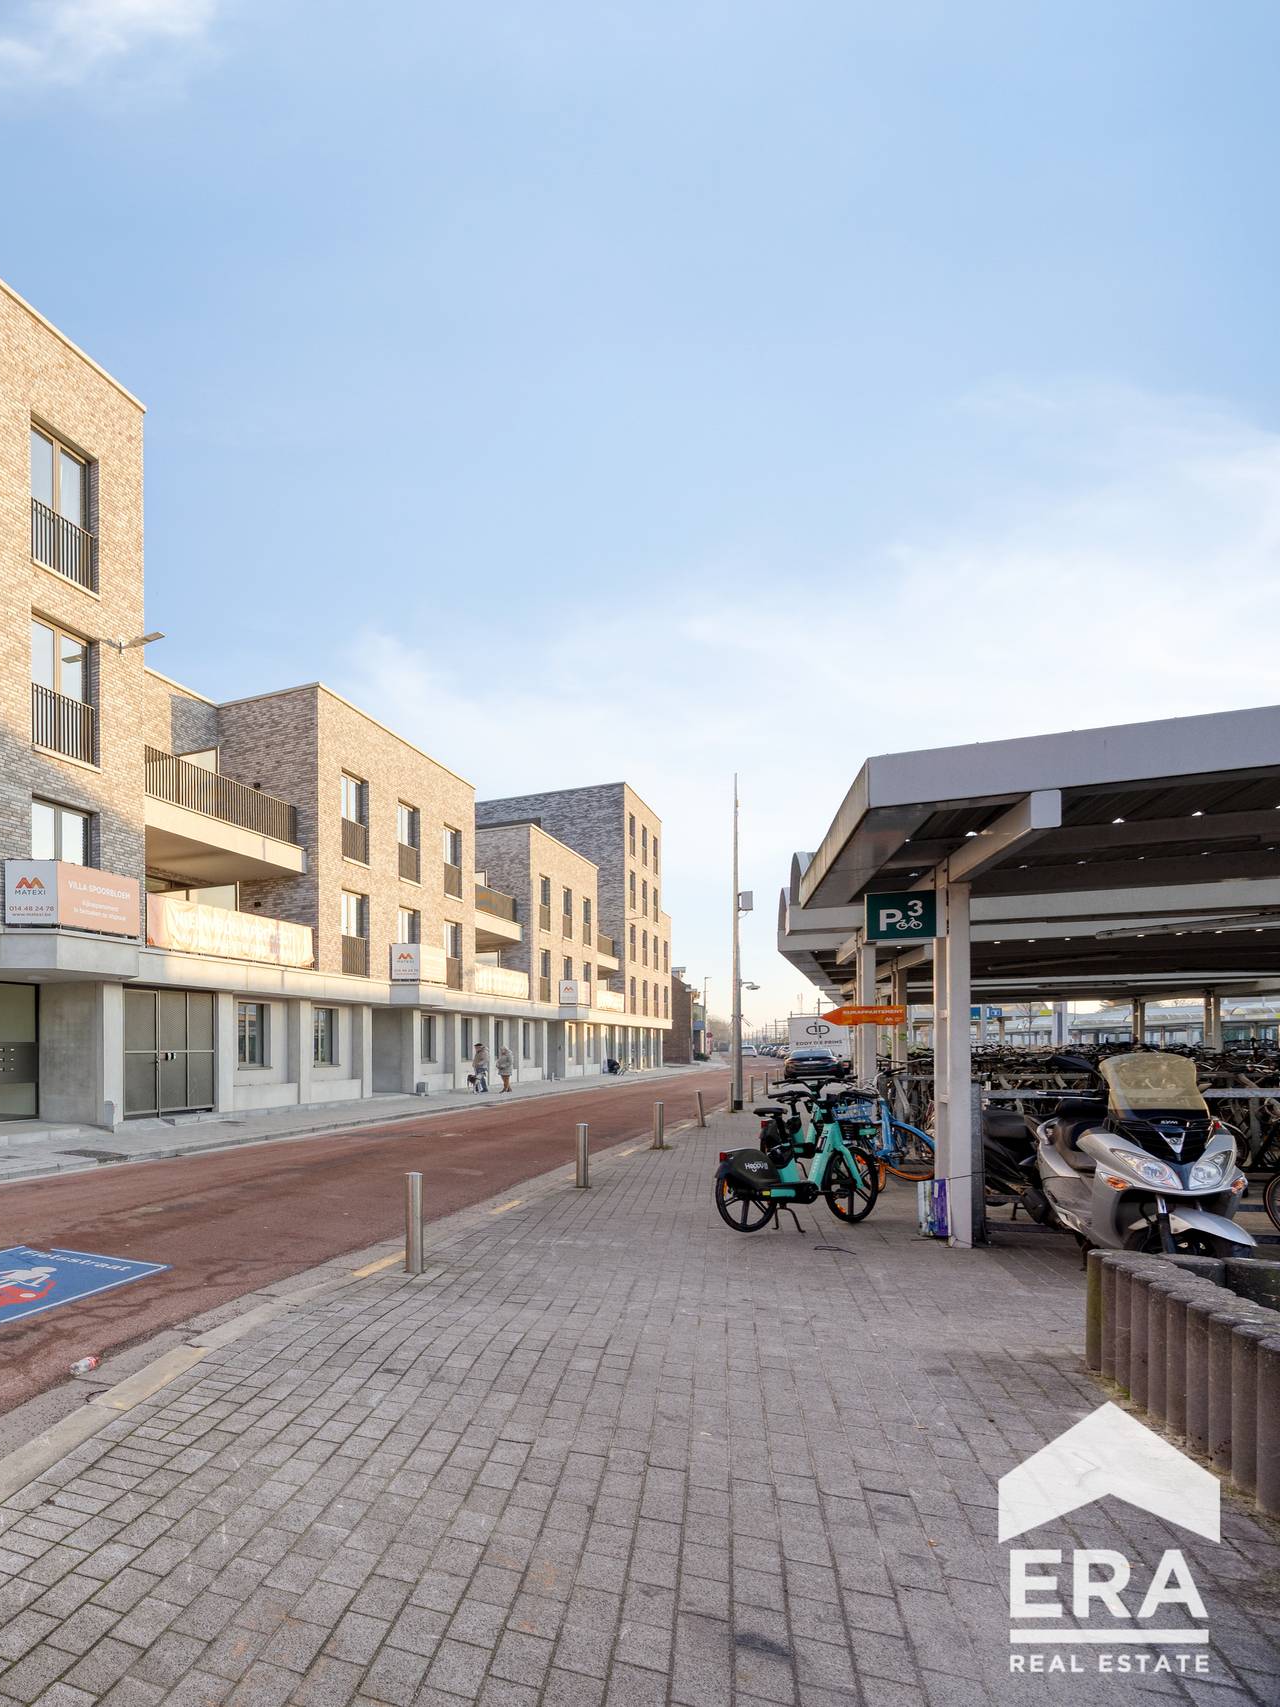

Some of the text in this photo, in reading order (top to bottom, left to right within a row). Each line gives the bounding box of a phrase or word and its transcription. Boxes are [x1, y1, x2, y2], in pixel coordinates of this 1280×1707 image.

[880, 900, 923, 931] P 3
[20, 1250, 132, 1272] Fietsstraat
